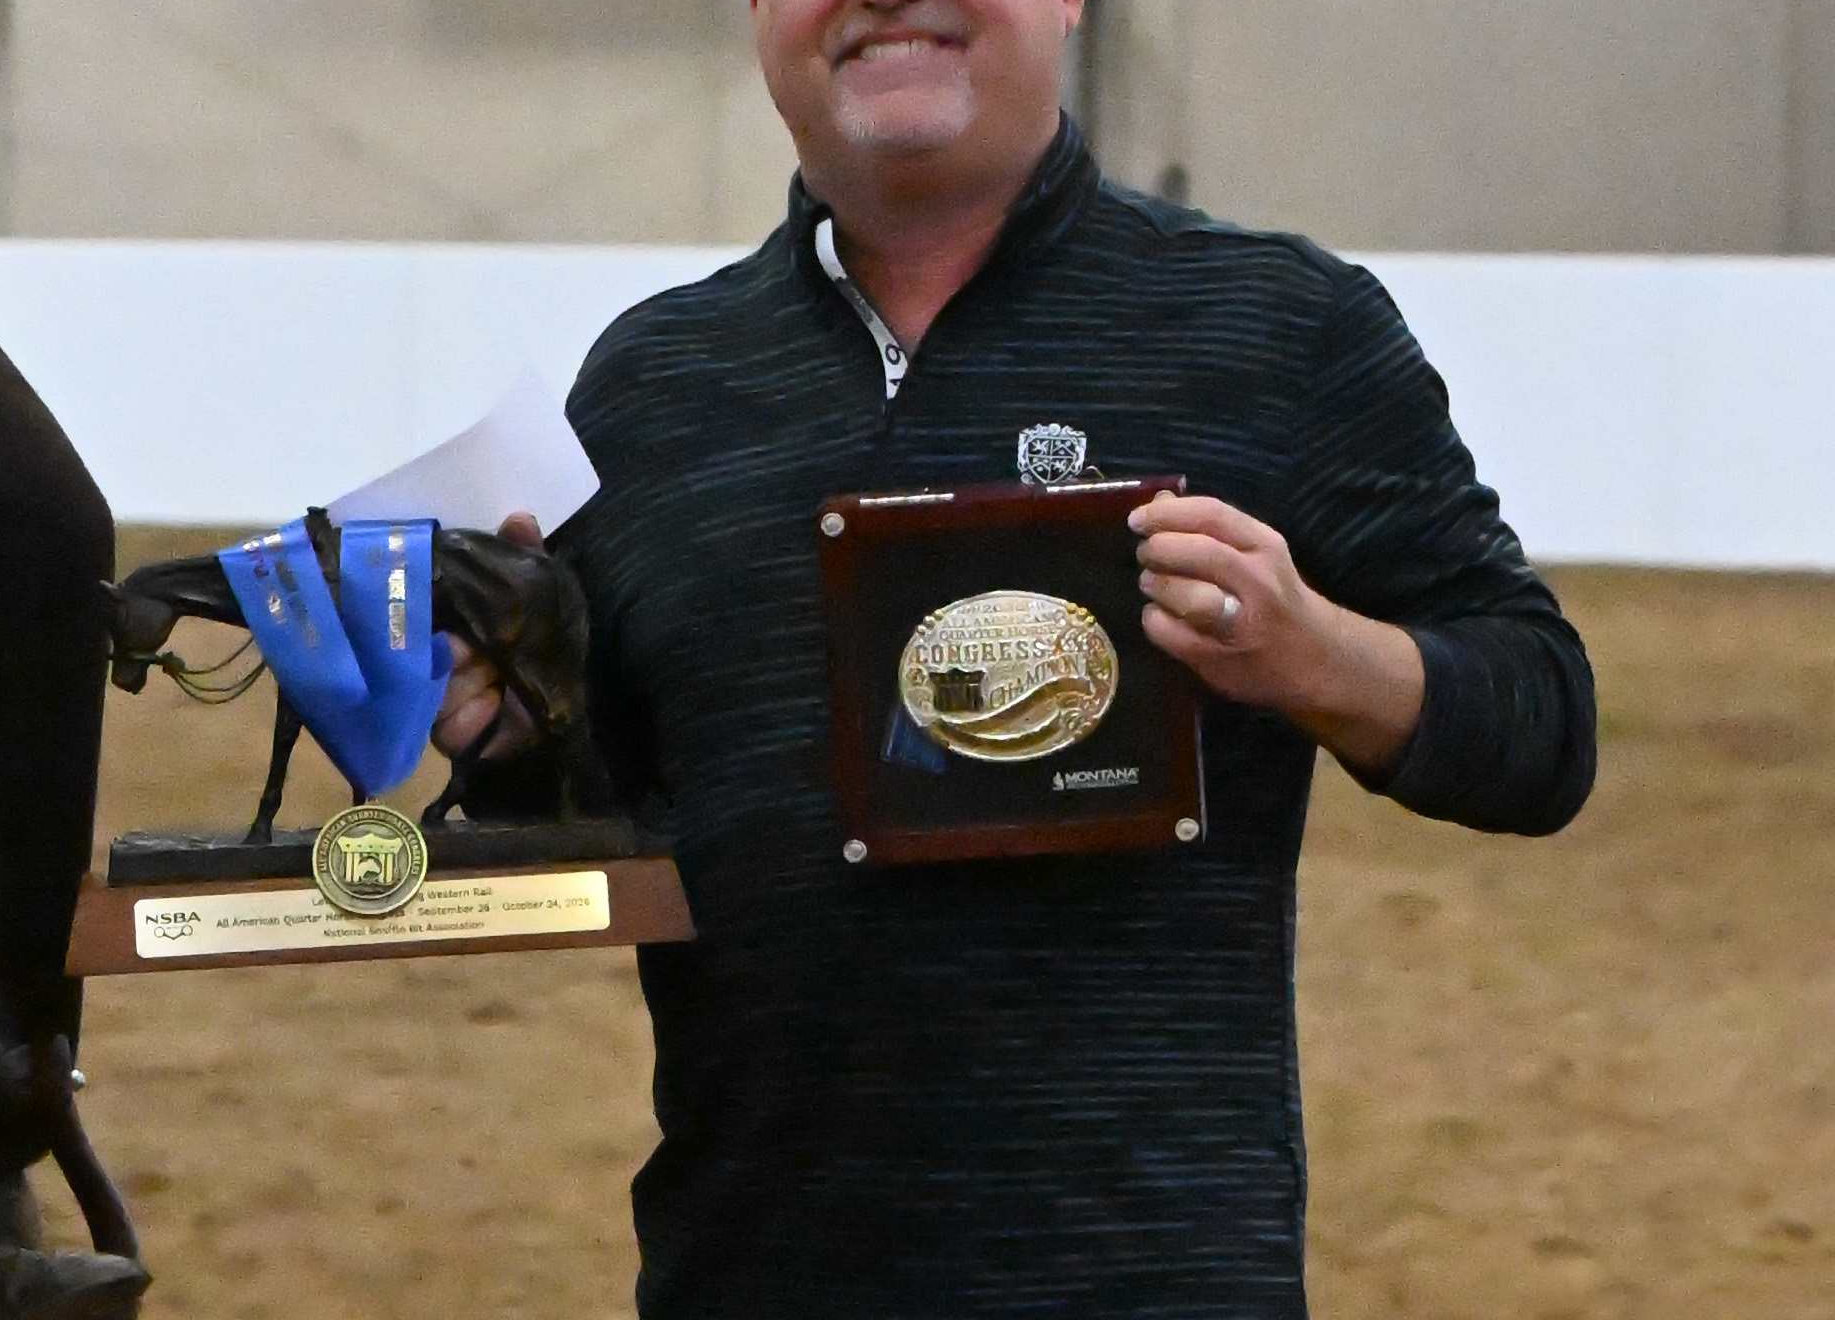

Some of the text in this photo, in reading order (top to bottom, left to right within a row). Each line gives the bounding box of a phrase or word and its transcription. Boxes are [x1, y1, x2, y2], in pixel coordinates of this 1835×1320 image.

[915, 641, 1048, 665] CONGRESS
[1065, 767, 1138, 784] MONTANA
[417, 904, 473, 916] September
[502, 900, 543, 911] October
[146, 911, 201, 925] NSBA
[232, 916, 280, 927] American
[283, 914, 322, 926] Quarter
